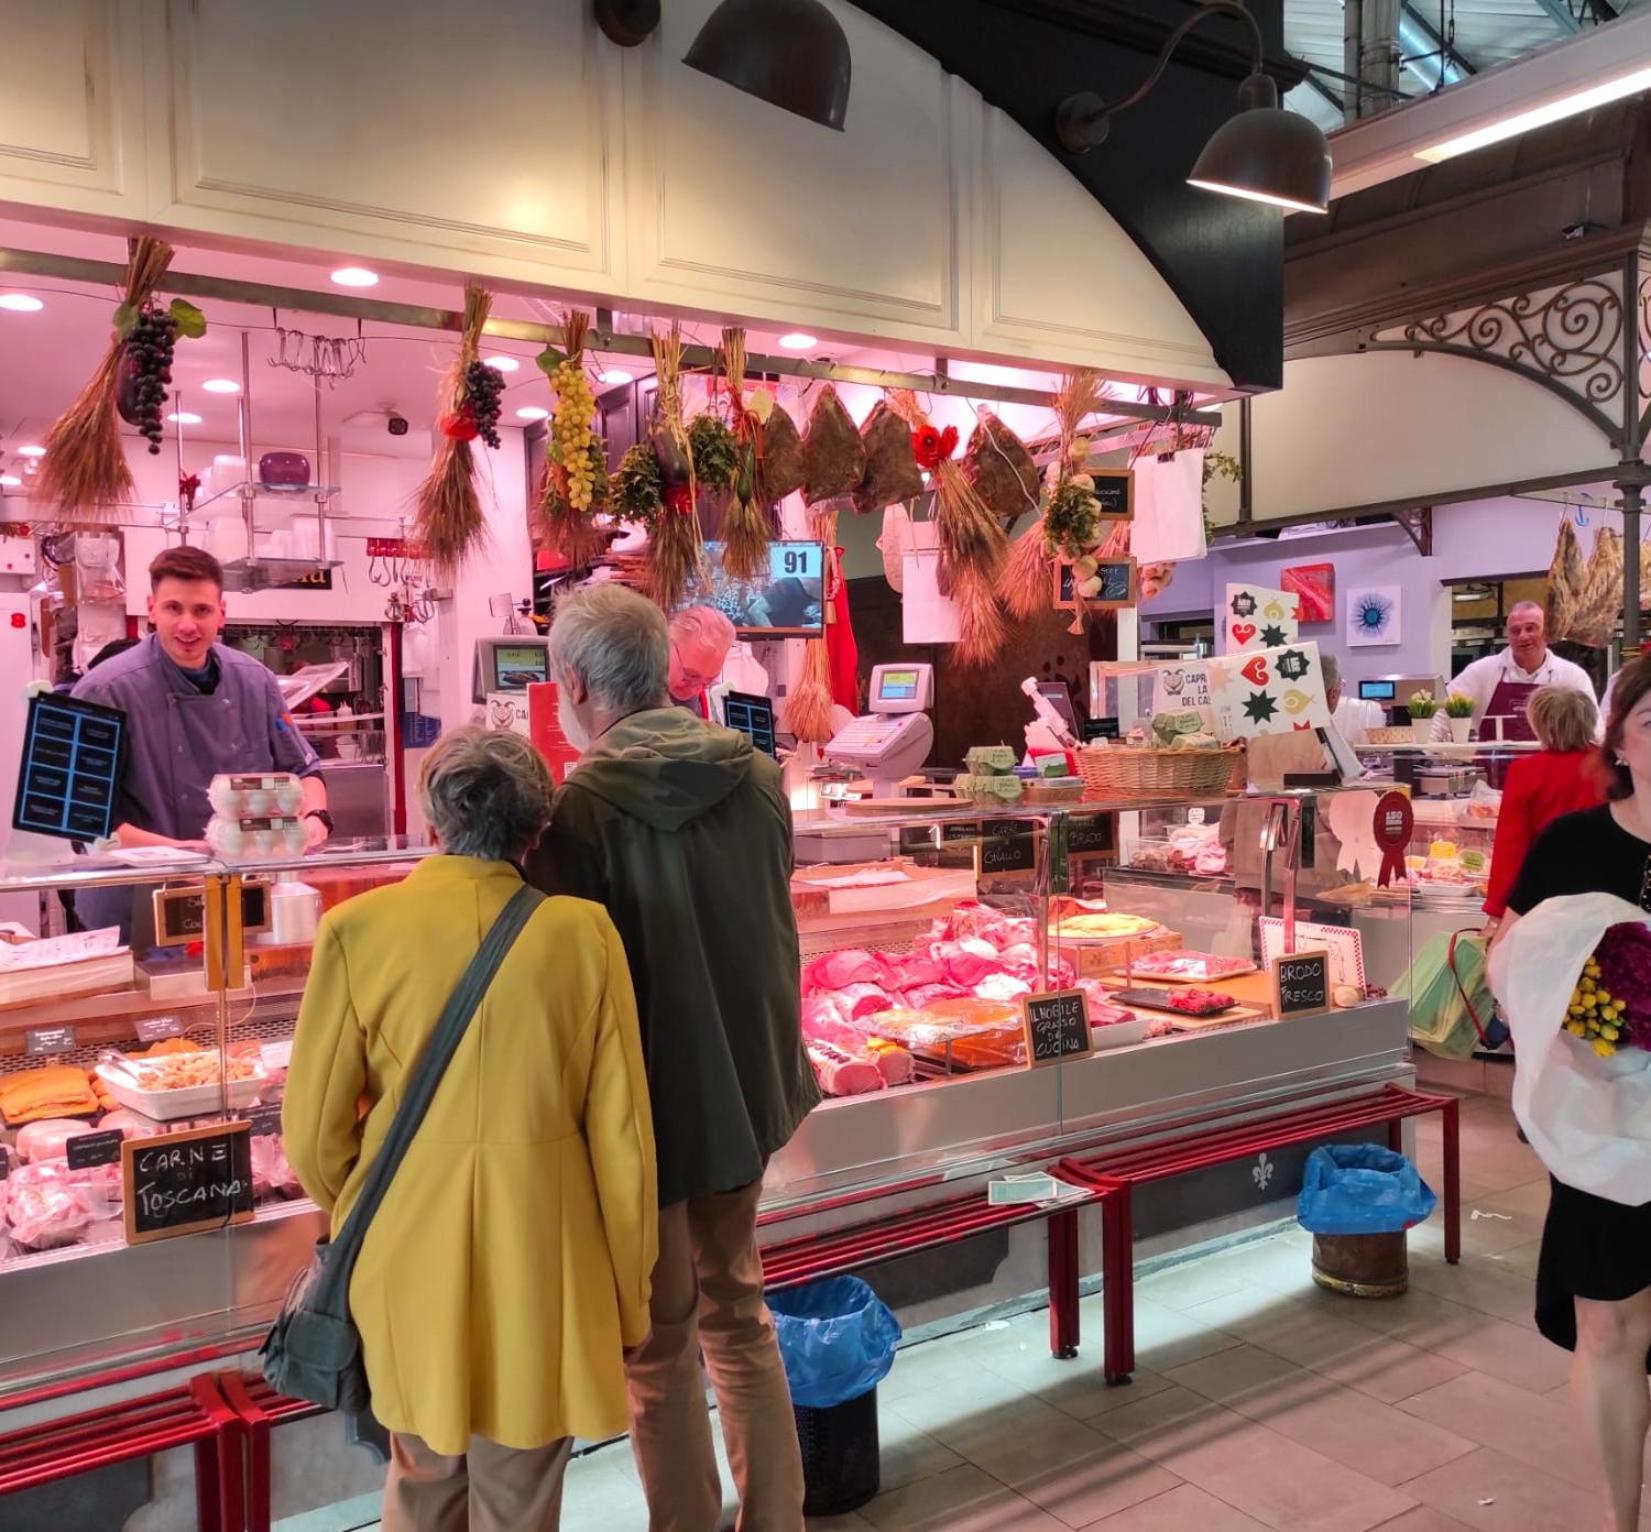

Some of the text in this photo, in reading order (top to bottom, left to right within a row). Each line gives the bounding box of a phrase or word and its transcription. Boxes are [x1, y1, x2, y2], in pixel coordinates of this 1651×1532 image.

[784, 551, 807, 574] 91
[1182, 696, 1196, 707] DEL
[1280, 962, 1321, 983] BRODO
[1281, 986, 1323, 1003] FRESCO
[1029, 1002, 1079, 1023] IL NOBILE
[1036, 1018, 1077, 1033] GRASSO
[1036, 1038, 1079, 1056] CUCINA
[139, 1144, 227, 1173] CARNE
[136, 1181, 242, 1216] TOSCANA
